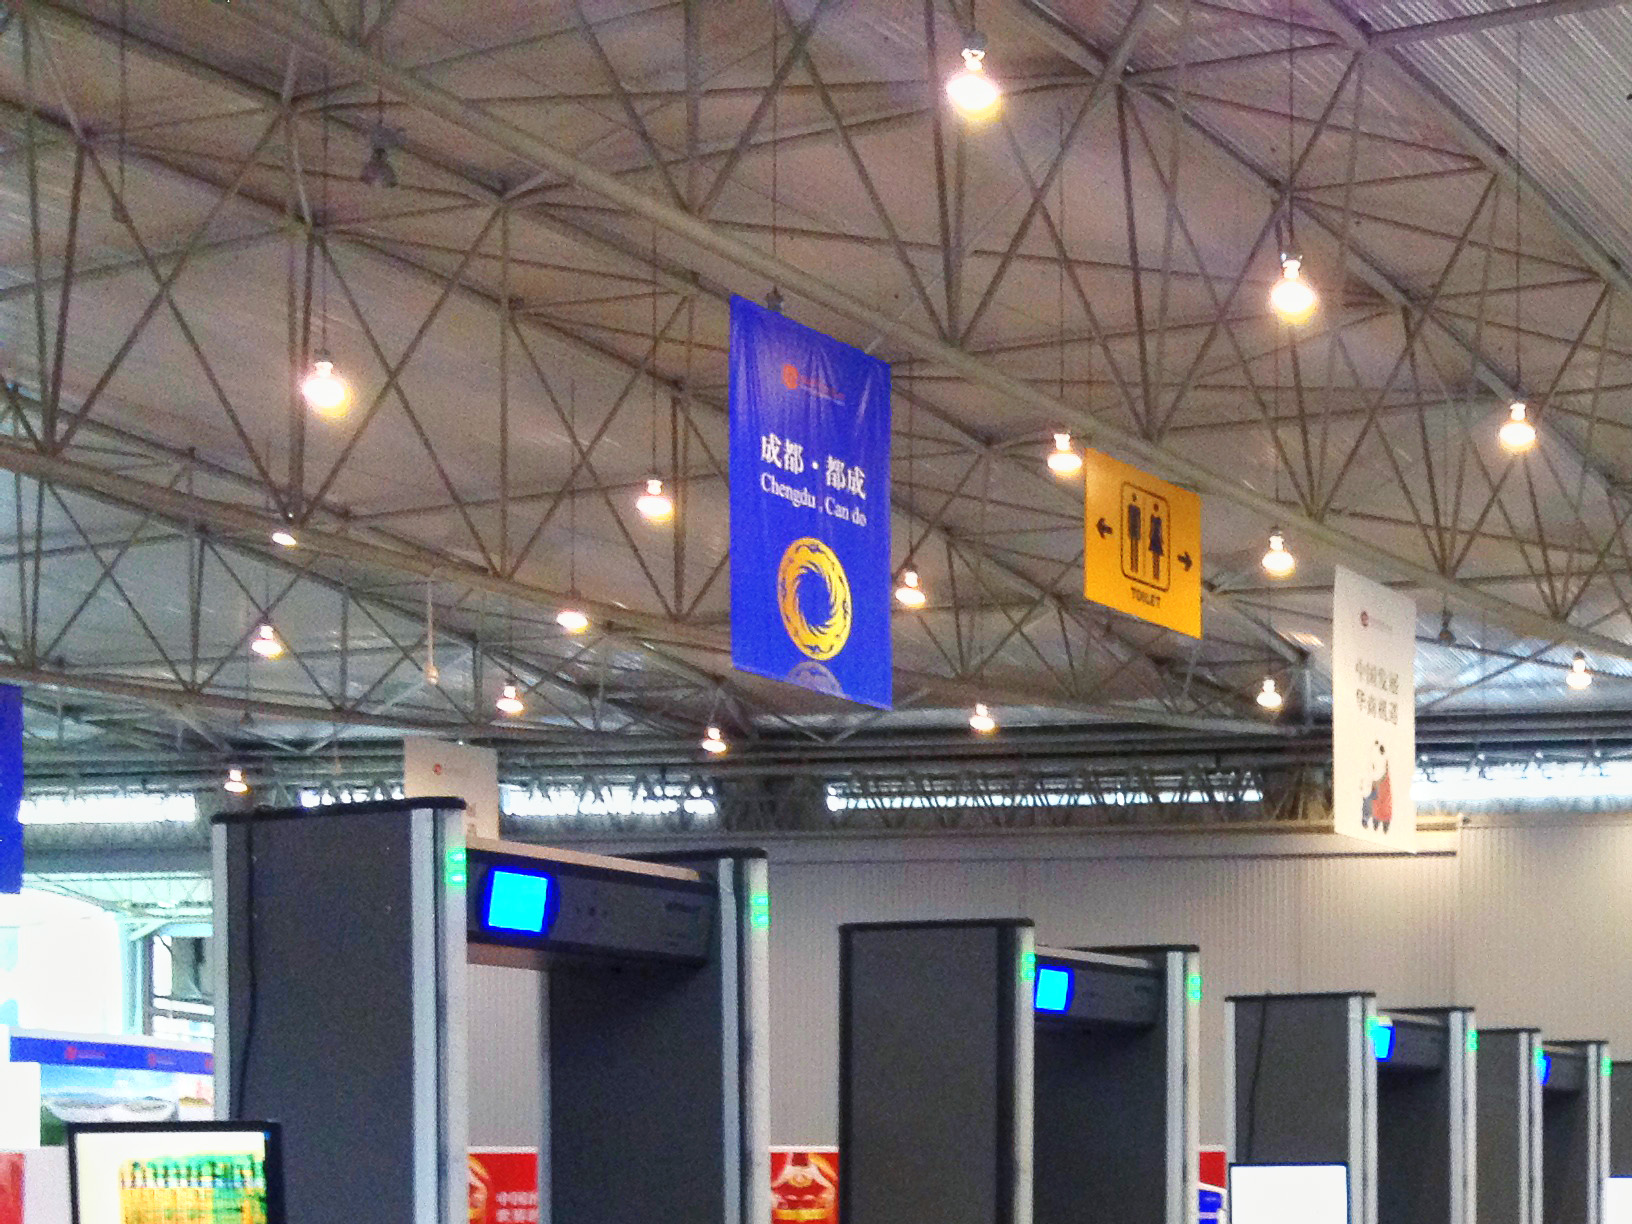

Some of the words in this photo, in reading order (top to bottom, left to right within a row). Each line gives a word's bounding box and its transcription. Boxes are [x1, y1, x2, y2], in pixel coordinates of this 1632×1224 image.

[824, 497, 850, 521] Can
[851, 506, 868, 528] do
[1130, 586, 1161, 608] TOILET
